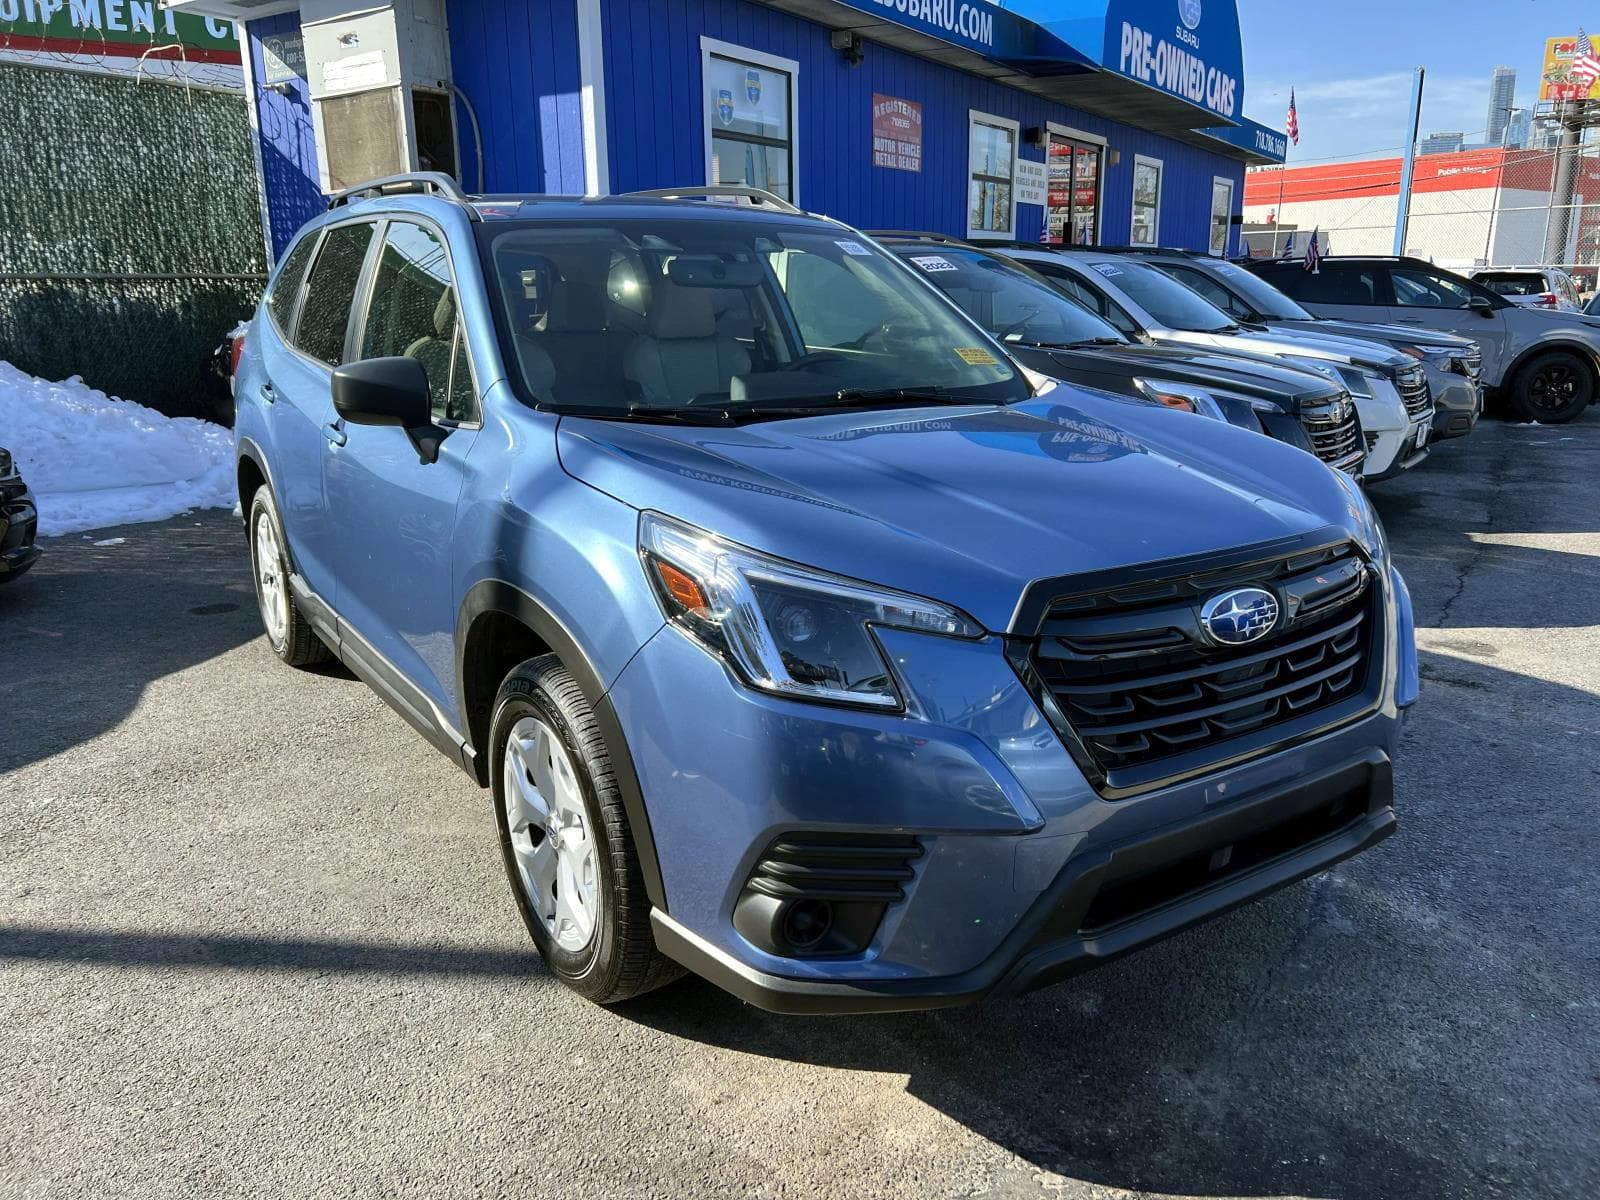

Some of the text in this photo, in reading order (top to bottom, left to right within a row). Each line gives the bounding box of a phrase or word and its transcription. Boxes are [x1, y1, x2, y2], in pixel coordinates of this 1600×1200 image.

[1175, 25, 1200, 49] SUBARU
[1119, 21, 1236, 118] PRE-OWNED CARS
[874, 100, 921, 125] REGISTERED
[874, 137, 921, 158] MOTOR VEHICLE
[875, 151, 920, 171] RETAIL DEALER
[1437, 167, 1461, 176] Public
[922, 262, 954, 270] 2023
